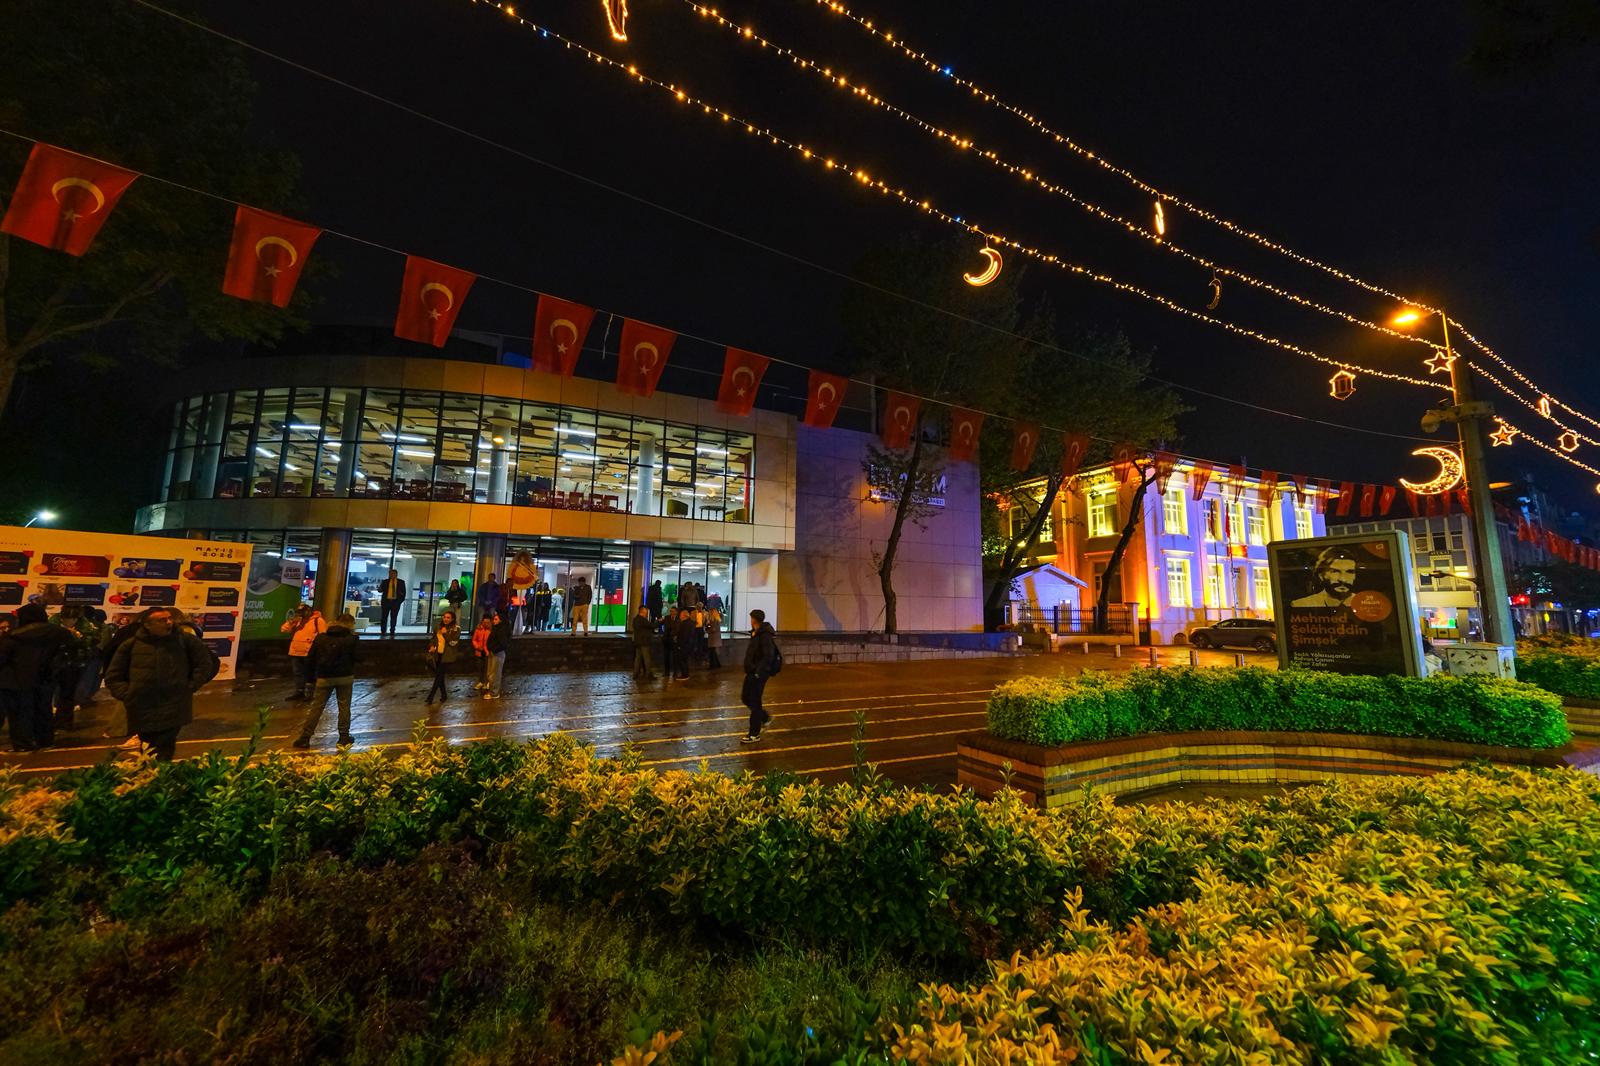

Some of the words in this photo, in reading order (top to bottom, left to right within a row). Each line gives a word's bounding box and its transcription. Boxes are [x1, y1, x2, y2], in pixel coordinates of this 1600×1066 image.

[202, 551, 233, 559] 2026
[245, 600, 265, 609] UZUR
[244, 609, 274, 619] ORİDORU
